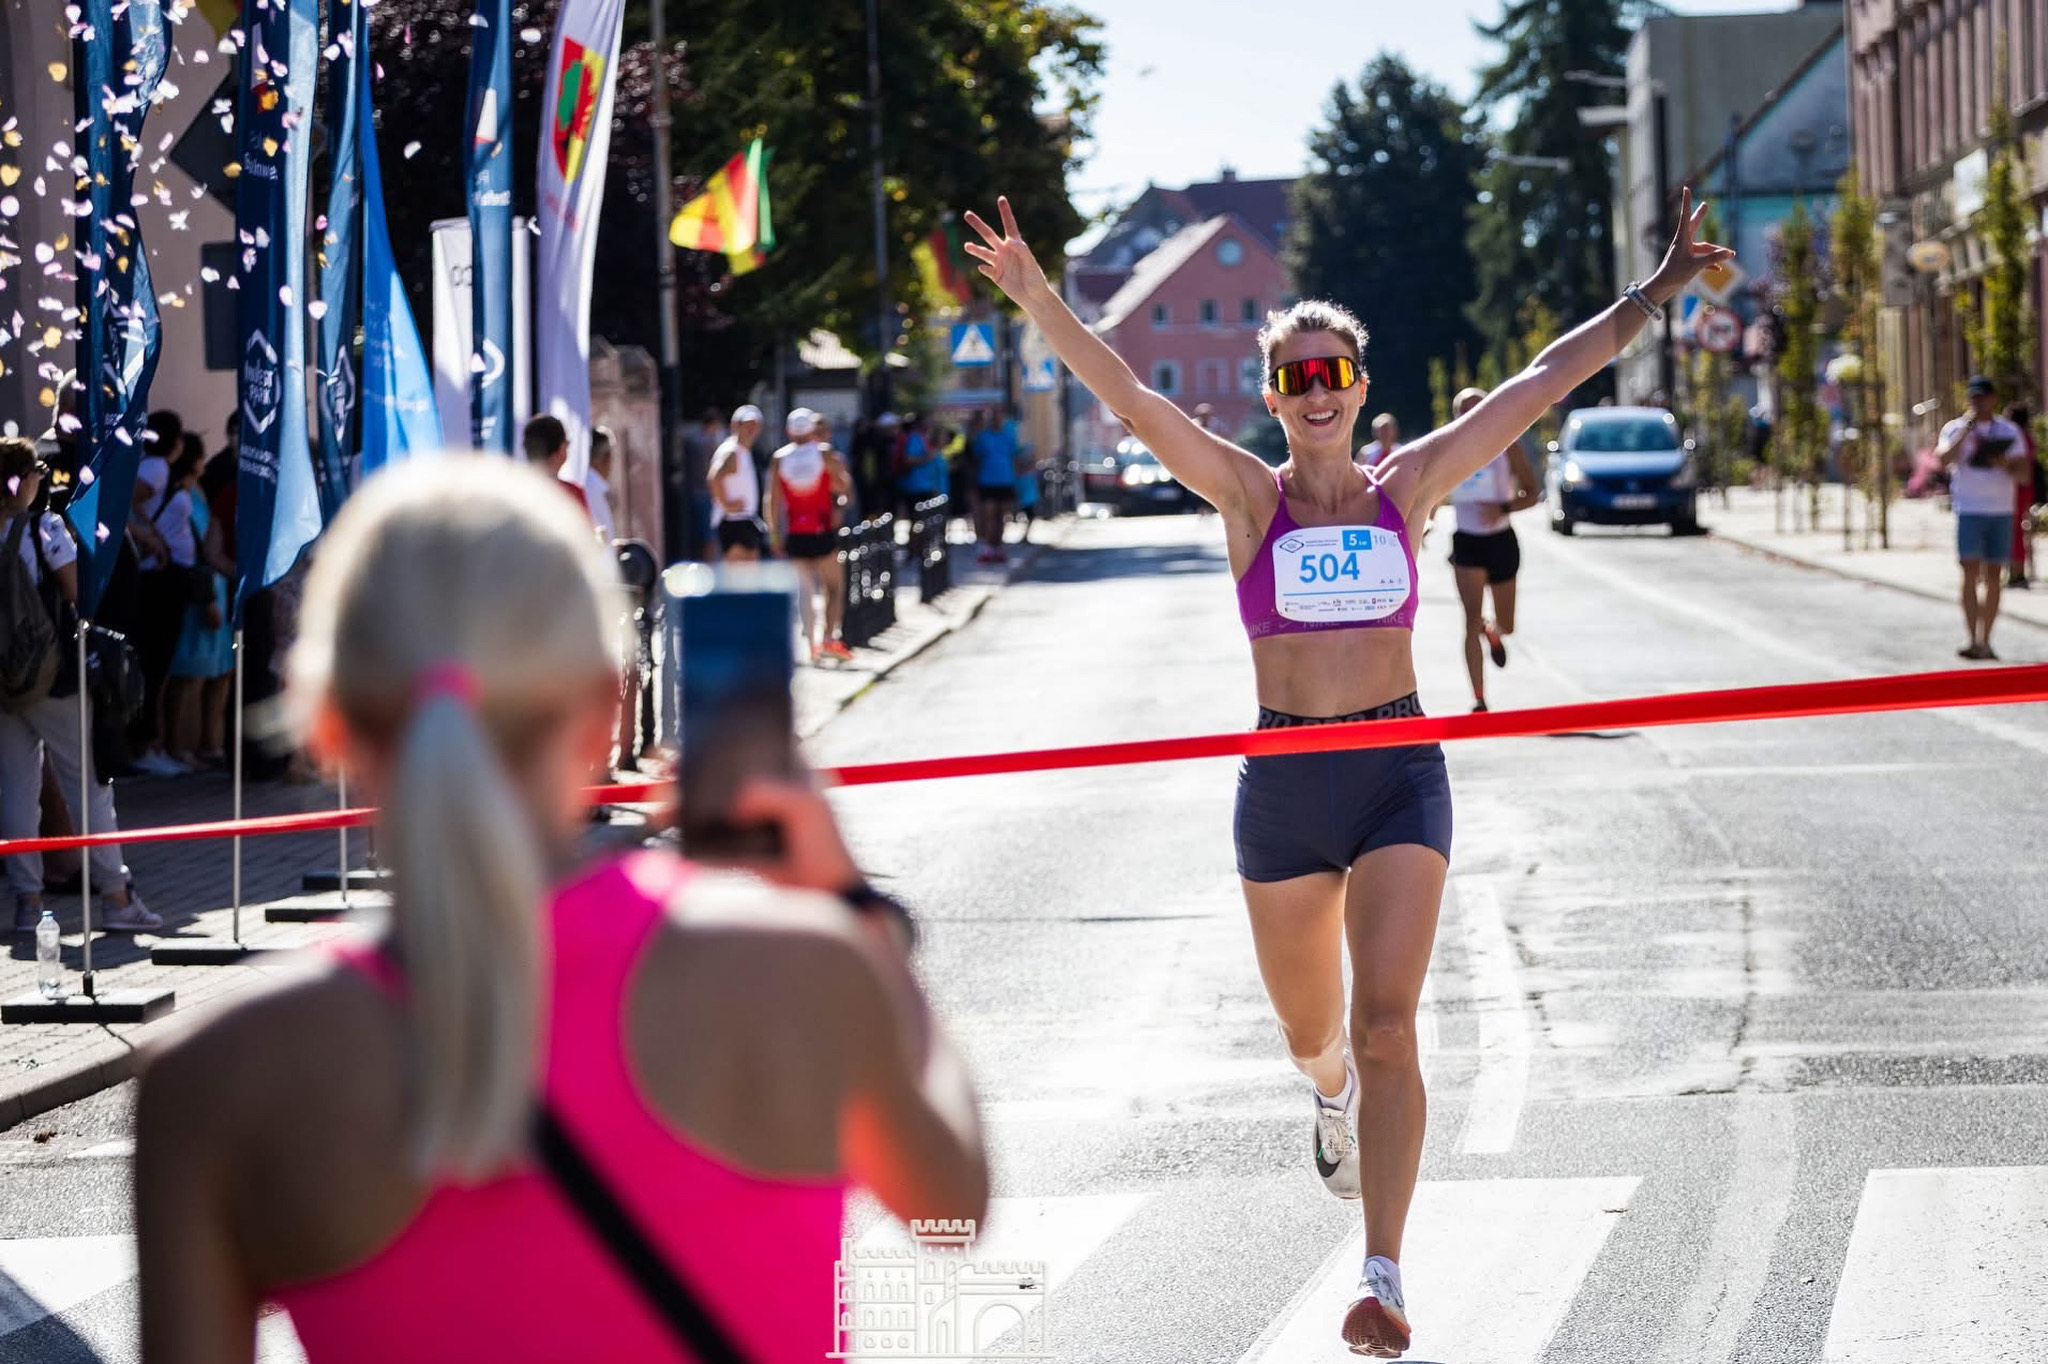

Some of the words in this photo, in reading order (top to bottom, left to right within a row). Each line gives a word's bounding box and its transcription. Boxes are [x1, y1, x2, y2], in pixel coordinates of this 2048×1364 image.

[1349, 533, 1358, 546] 5
[1374, 534, 1387, 546] 10
[1299, 552, 1360, 584] 504
[1249, 620, 1271, 637] NIKE
